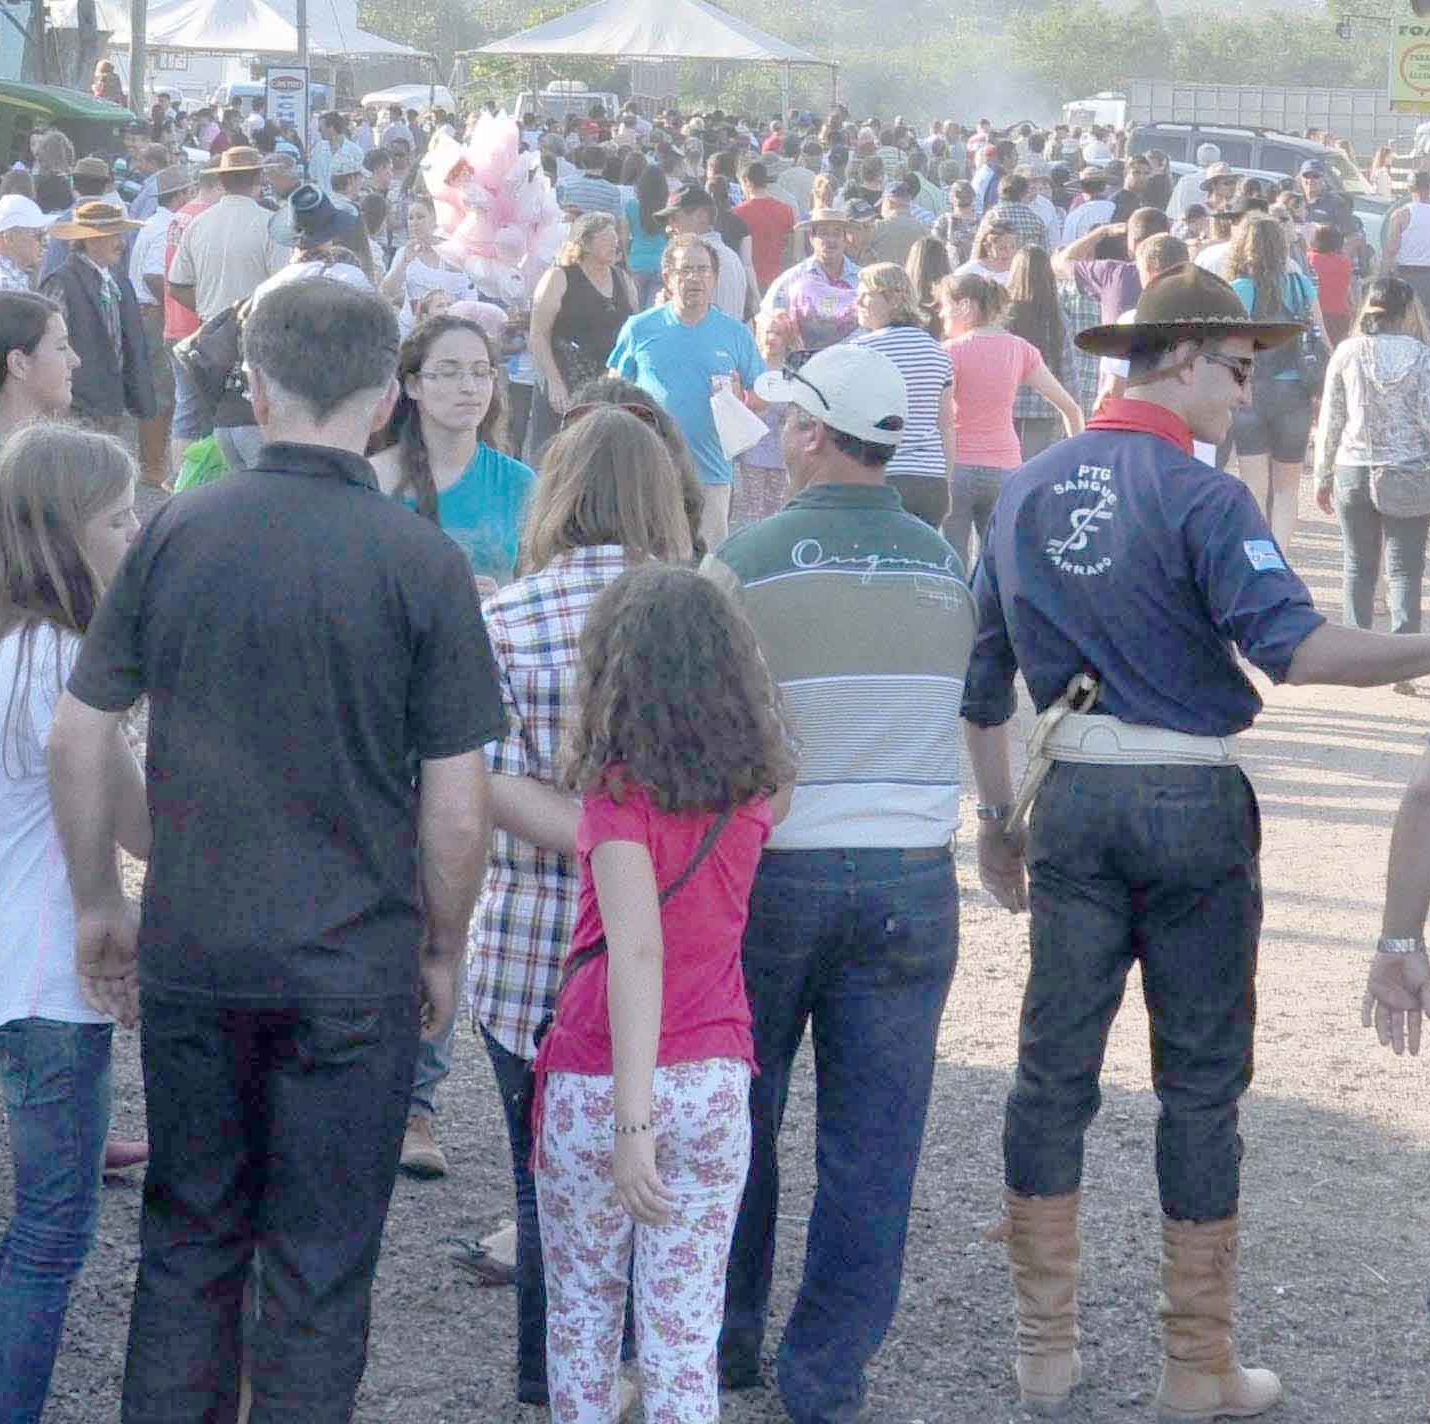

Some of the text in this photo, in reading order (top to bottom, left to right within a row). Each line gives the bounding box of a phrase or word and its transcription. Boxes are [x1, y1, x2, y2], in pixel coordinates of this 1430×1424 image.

[1078, 464, 1112, 481] PTG
[1054, 478, 1117, 505] SANGUE
[791, 538, 957, 584] Original
